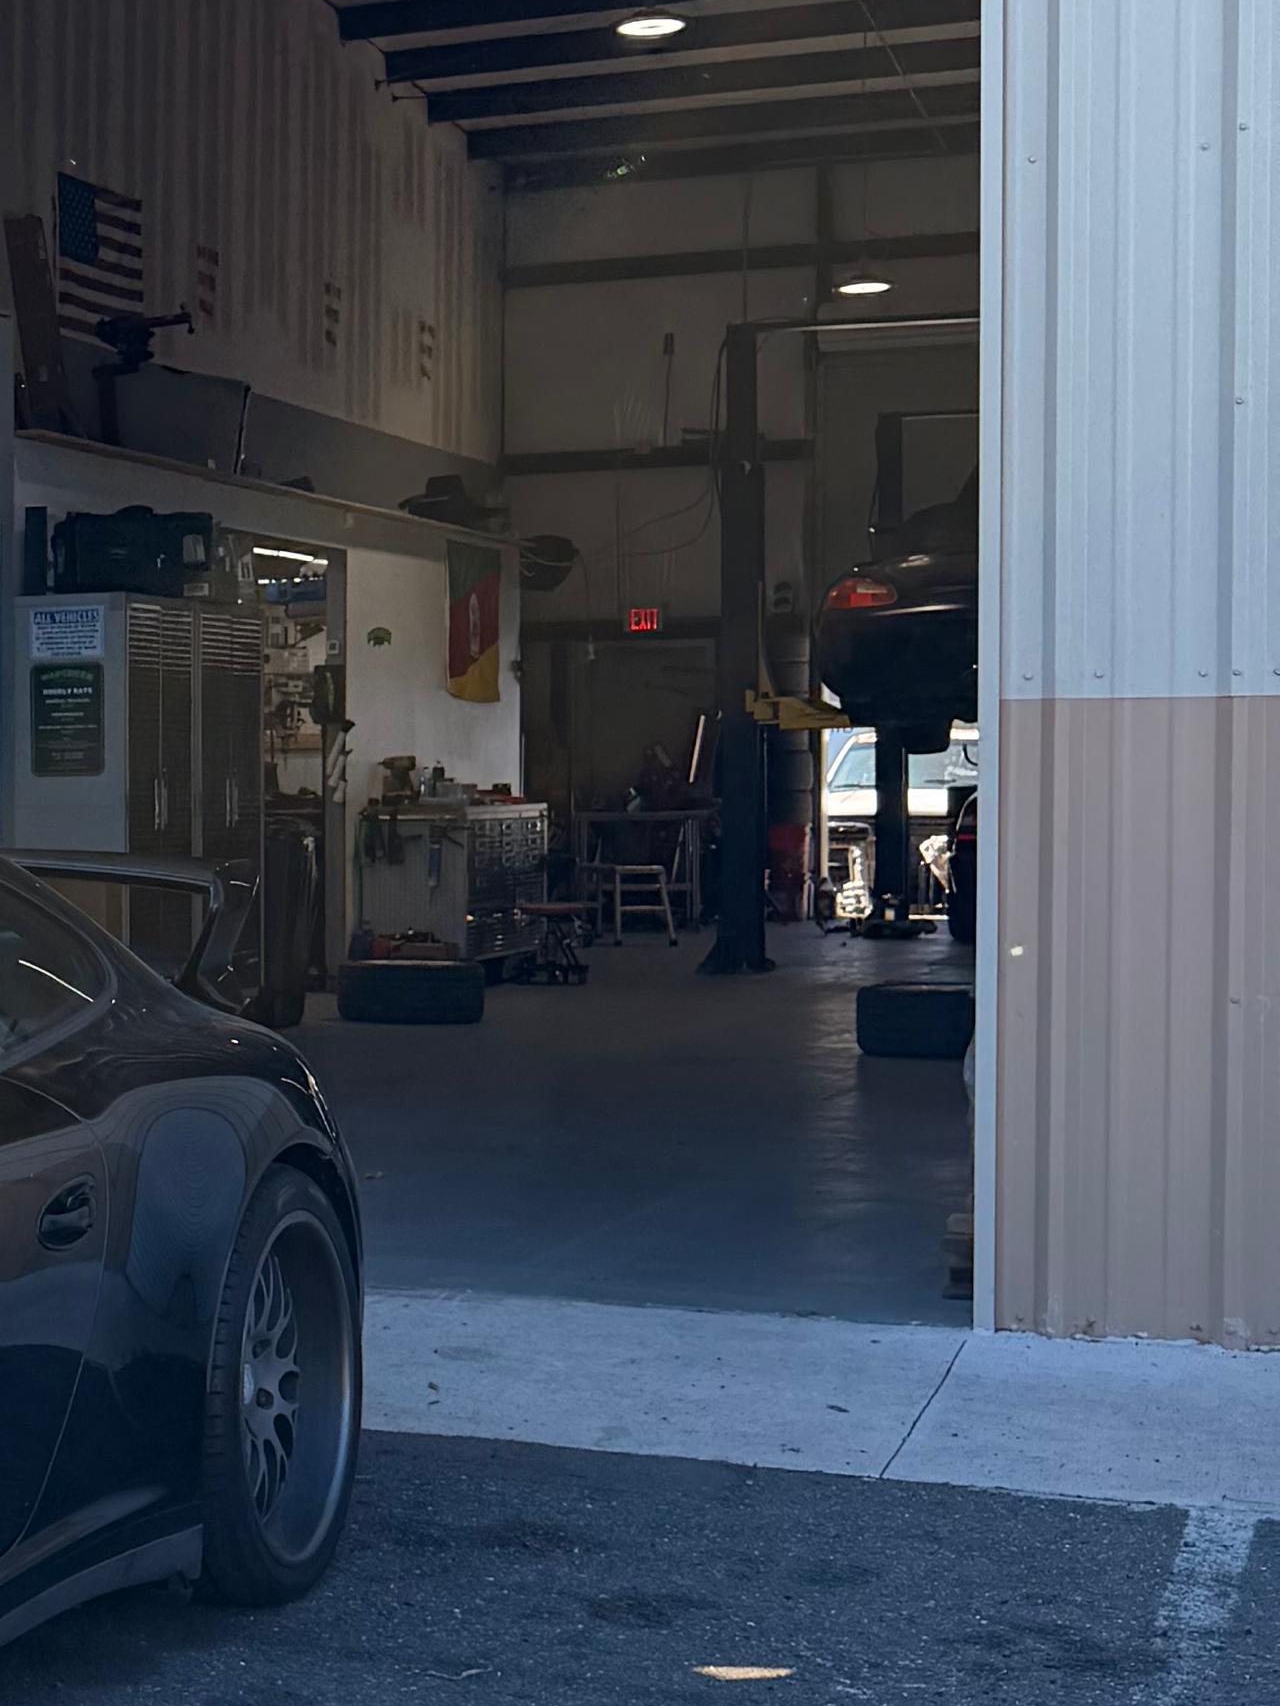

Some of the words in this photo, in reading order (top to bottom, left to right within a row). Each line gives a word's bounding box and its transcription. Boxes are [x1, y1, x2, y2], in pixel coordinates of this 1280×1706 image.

[34, 612, 53, 624] ALL
[54, 609, 98, 623] VEHICLES
[630, 608, 657, 631] EXIT
